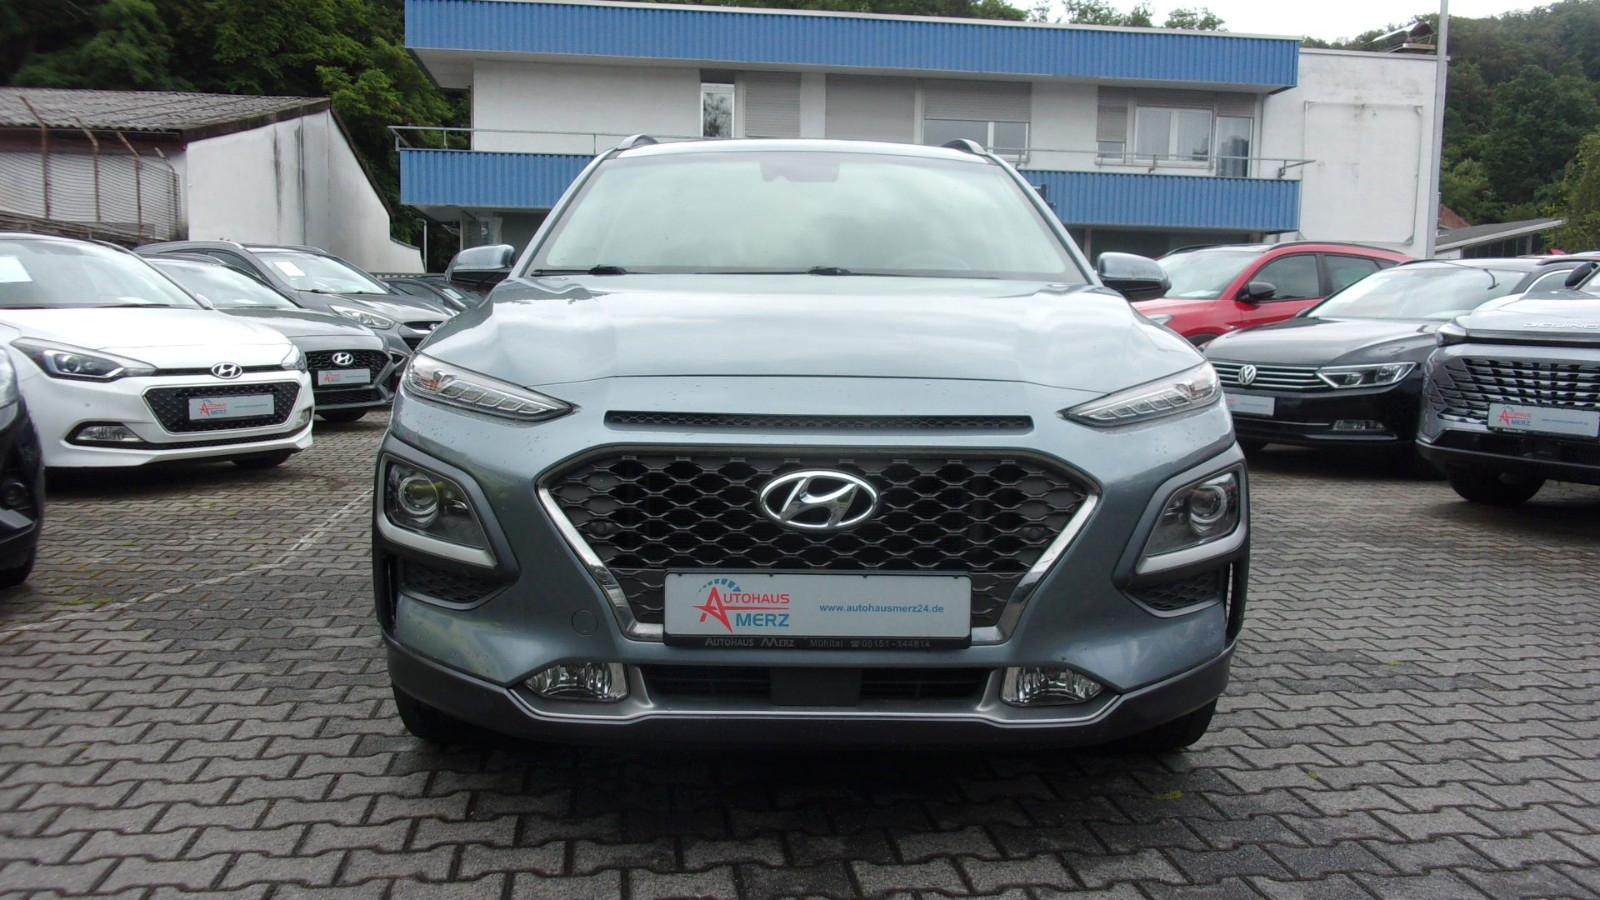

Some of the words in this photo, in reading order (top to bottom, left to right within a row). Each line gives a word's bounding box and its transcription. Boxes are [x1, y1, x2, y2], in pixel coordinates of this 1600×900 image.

[692, 587, 790, 632] AUTOHAUS
[819, 602, 945, 614] www.autohausmerz24.de
[735, 612, 790, 627] MERZ
[704, 638, 754, 648] AUTOHAUS
[760, 637, 795, 648] MERZ
